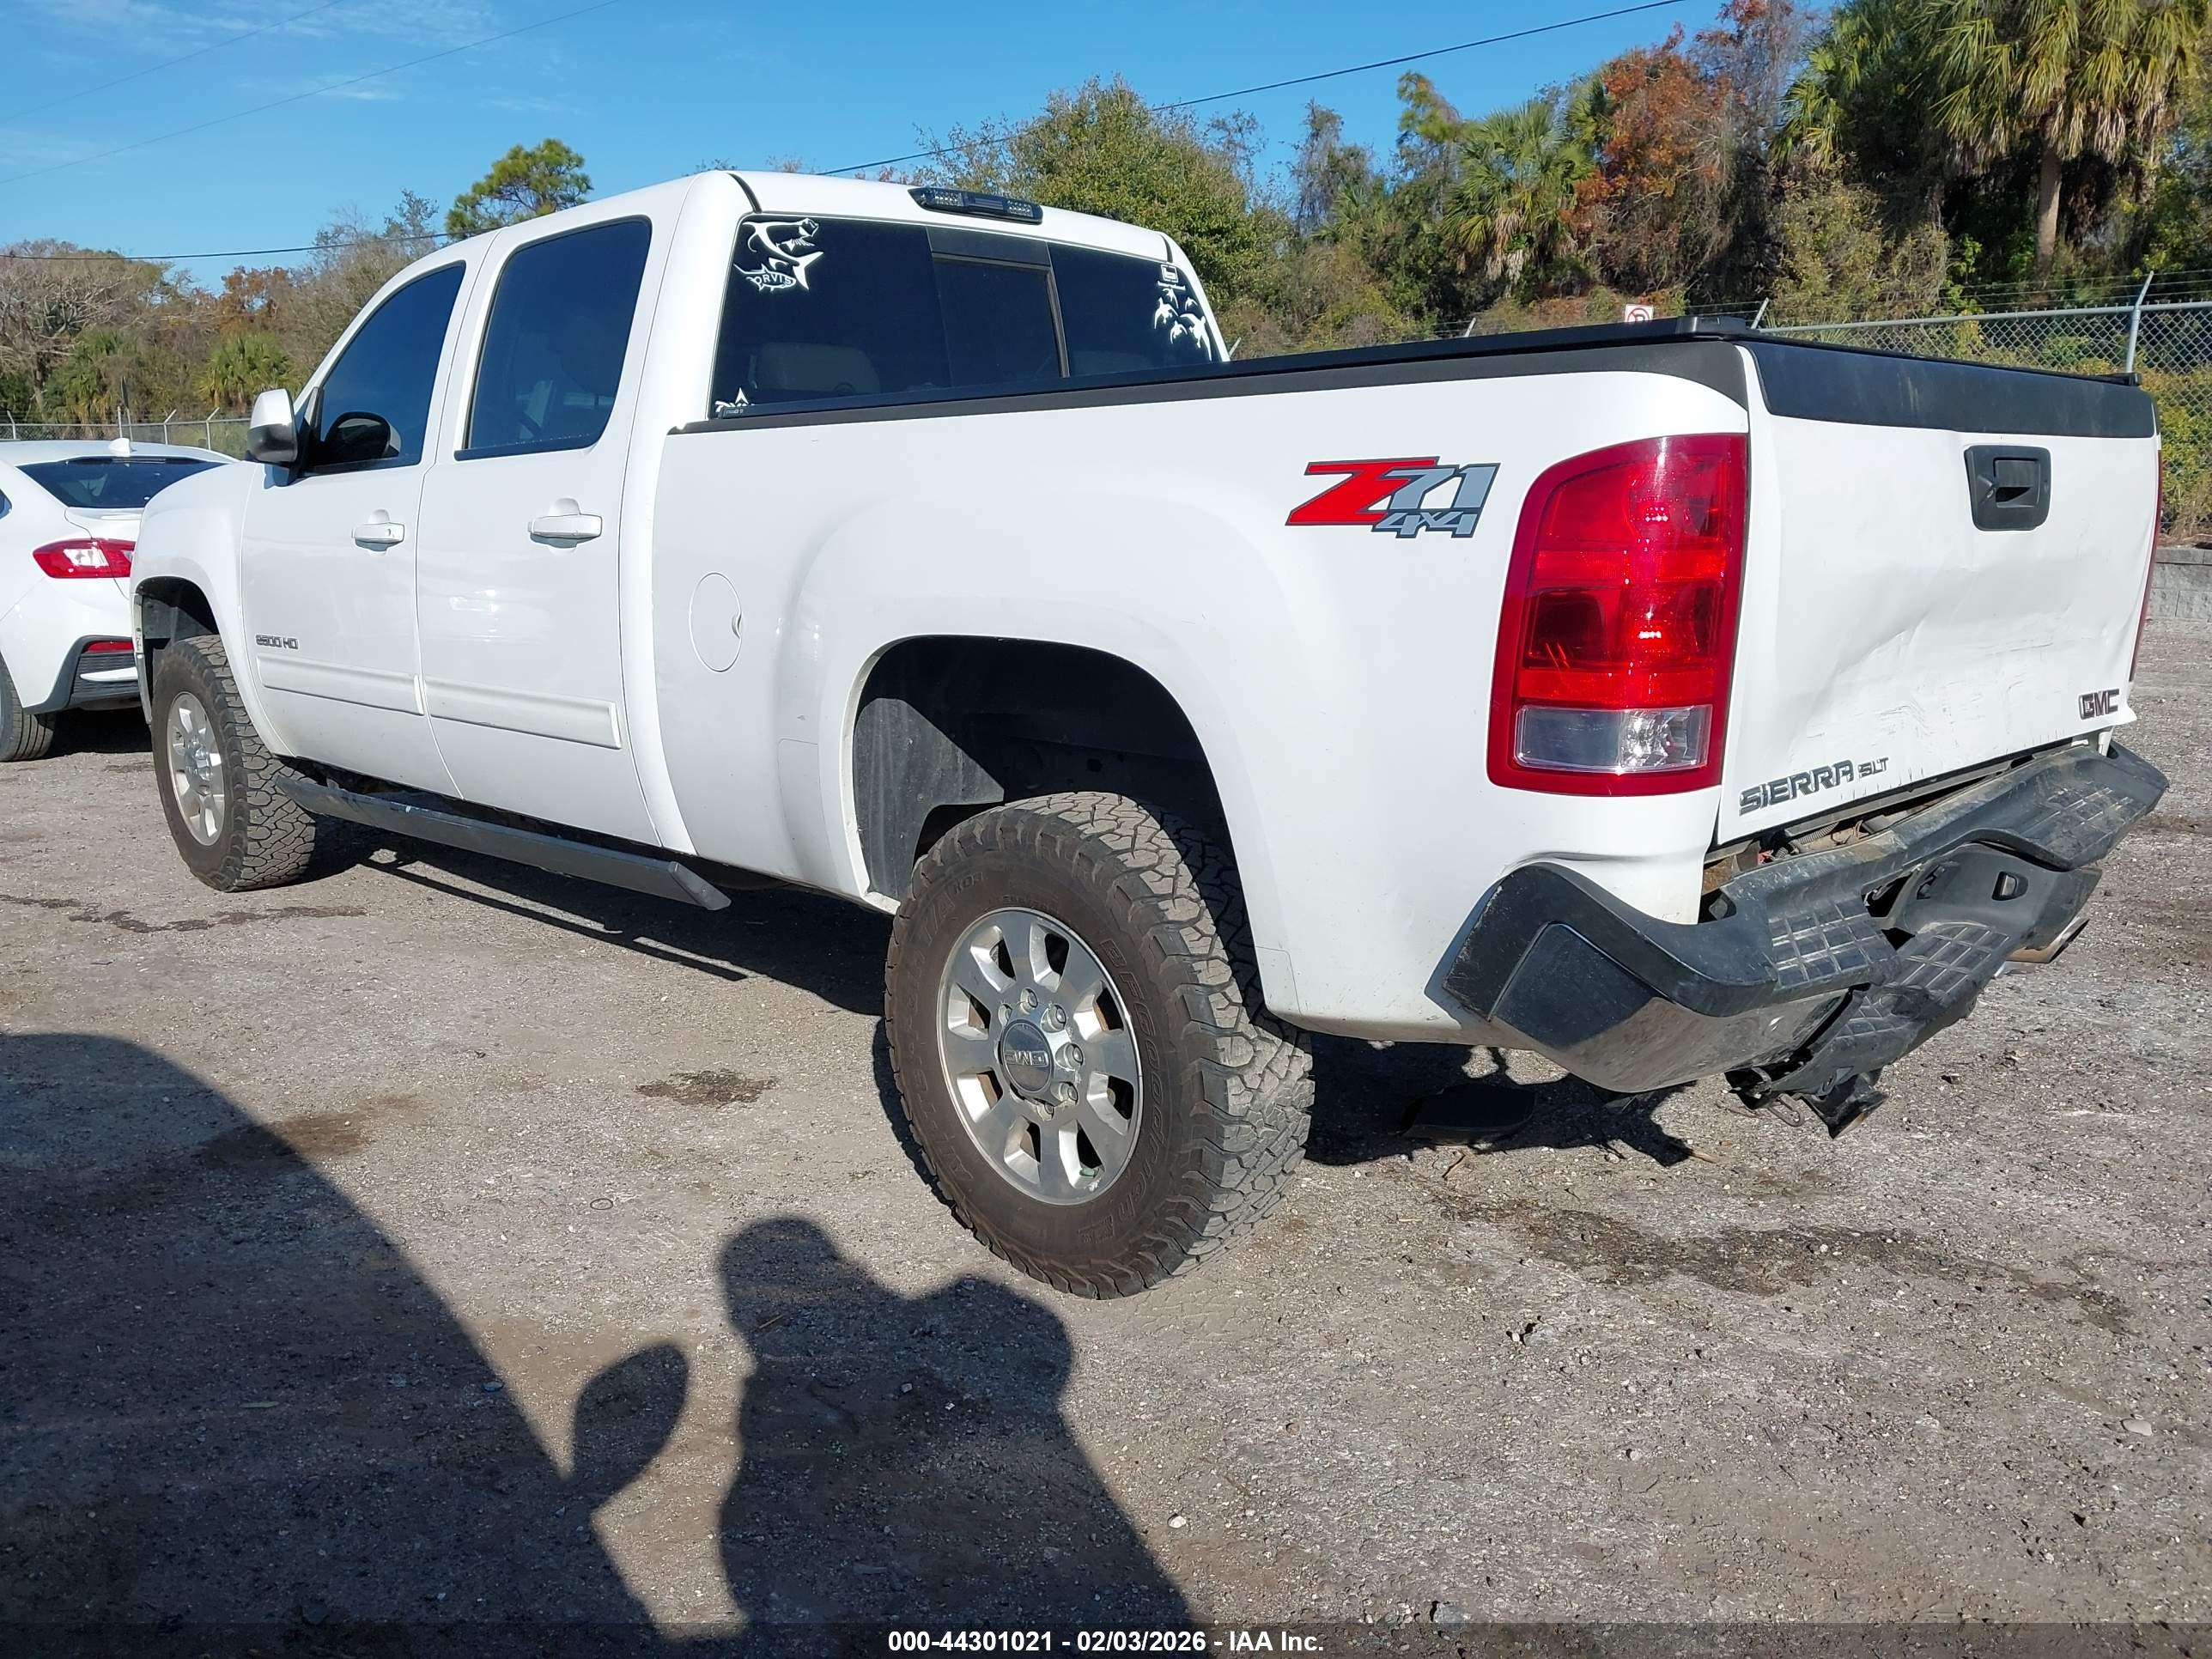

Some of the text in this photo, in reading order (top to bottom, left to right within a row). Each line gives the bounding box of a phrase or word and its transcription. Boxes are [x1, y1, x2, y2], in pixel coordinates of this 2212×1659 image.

[755, 273, 792, 285] ORVIS
[1285, 456, 1501, 526] Z71
[283, 637, 298, 649] HD
[2078, 689, 2120, 720] GMC
[1739, 757, 1889, 815] SIERRA SLT
[1005, 1050, 1048, 1066] GMC
